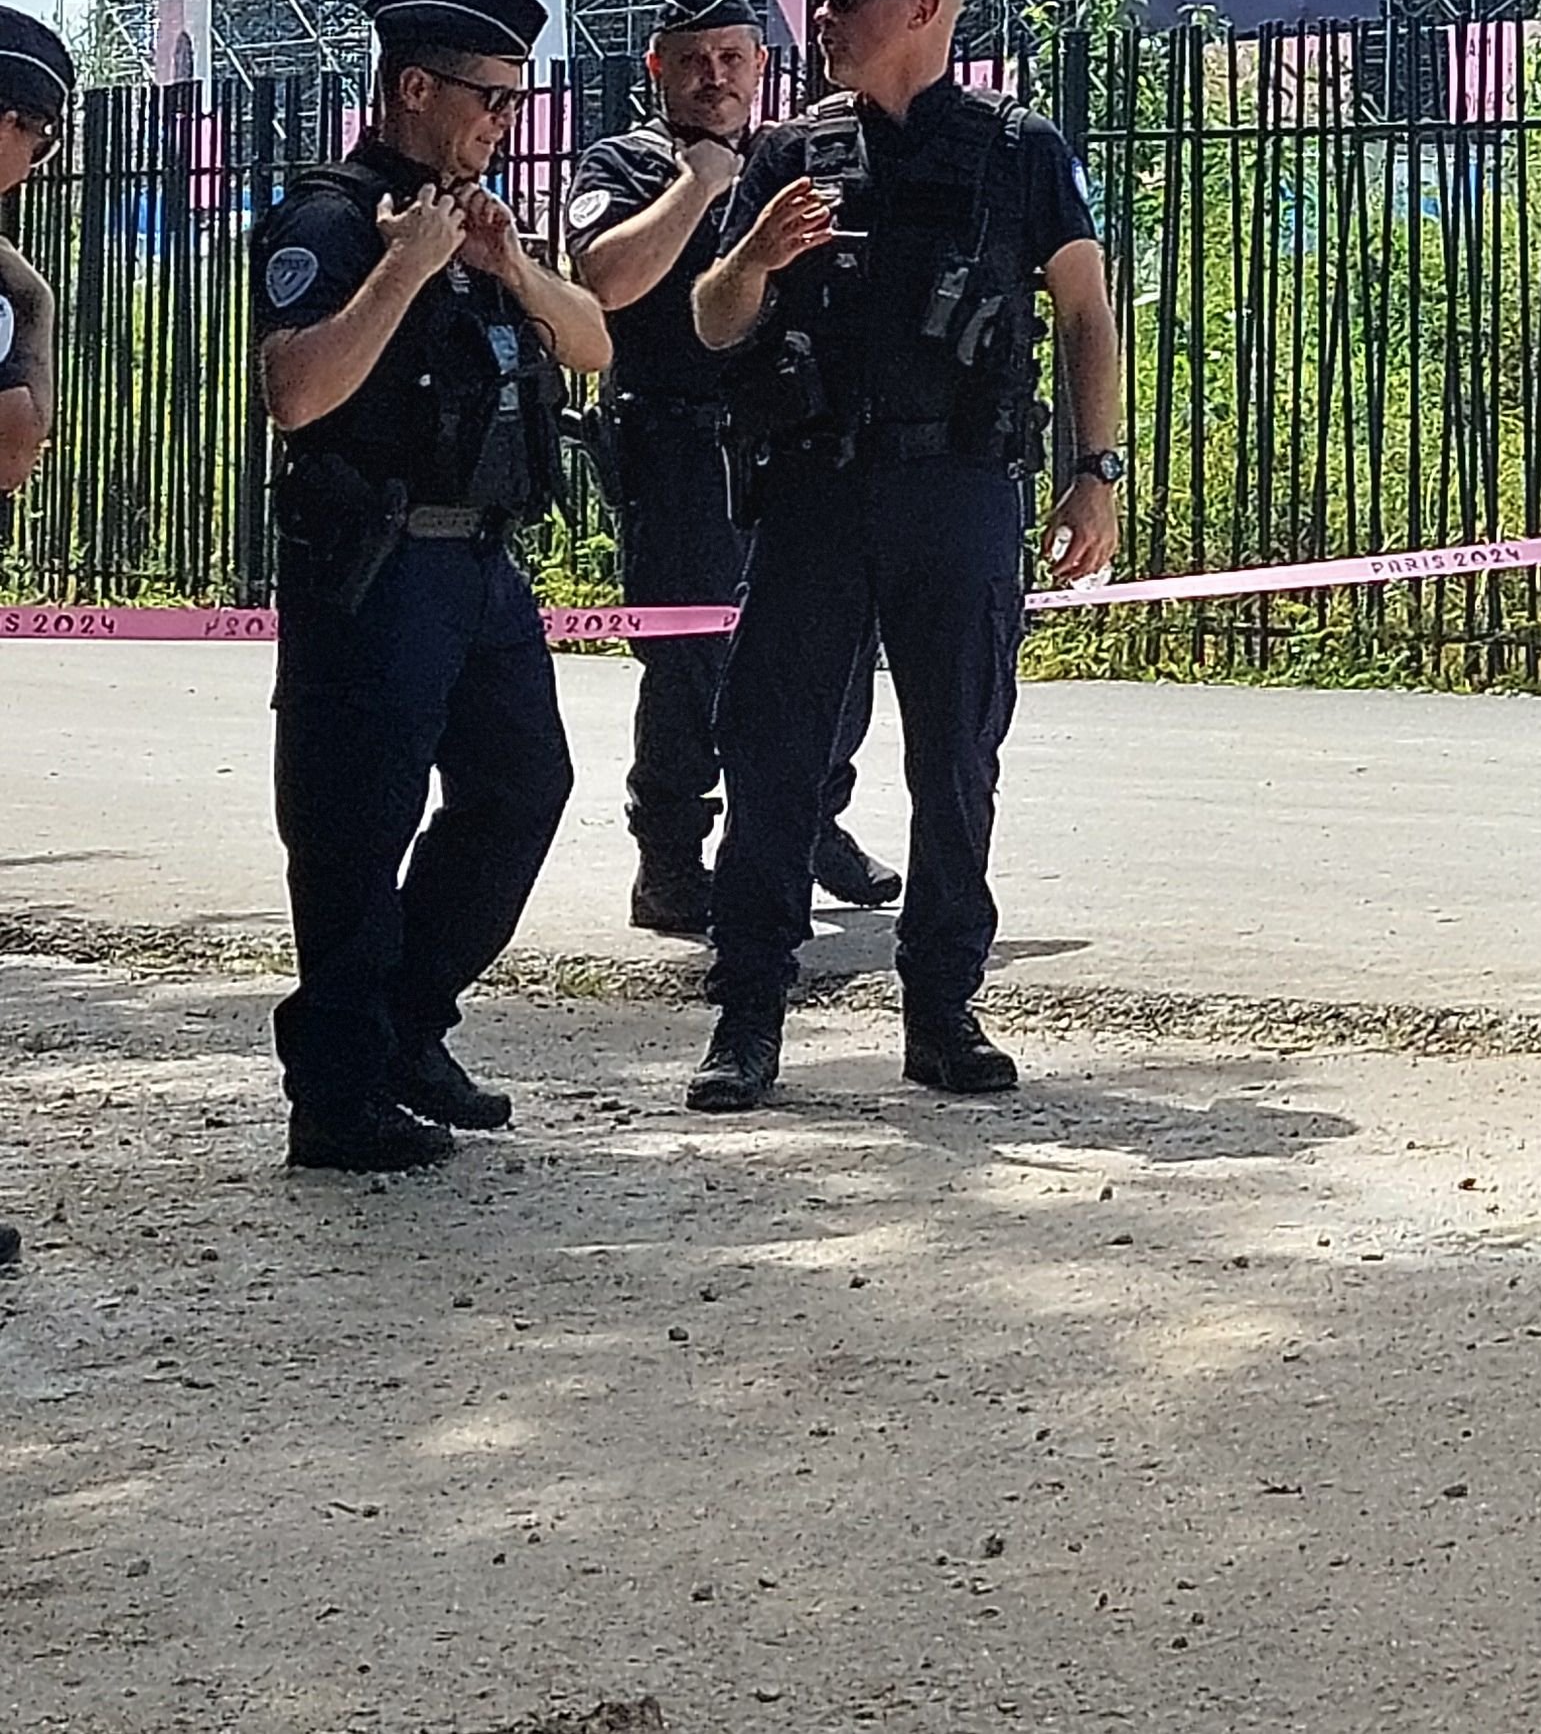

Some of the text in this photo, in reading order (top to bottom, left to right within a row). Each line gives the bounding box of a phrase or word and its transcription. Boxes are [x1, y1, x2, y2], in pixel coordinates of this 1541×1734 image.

[1370, 547, 1520, 574] PARIS 2024
[32, 613, 116, 634] 2024
[565, 613, 641, 634] 2024
